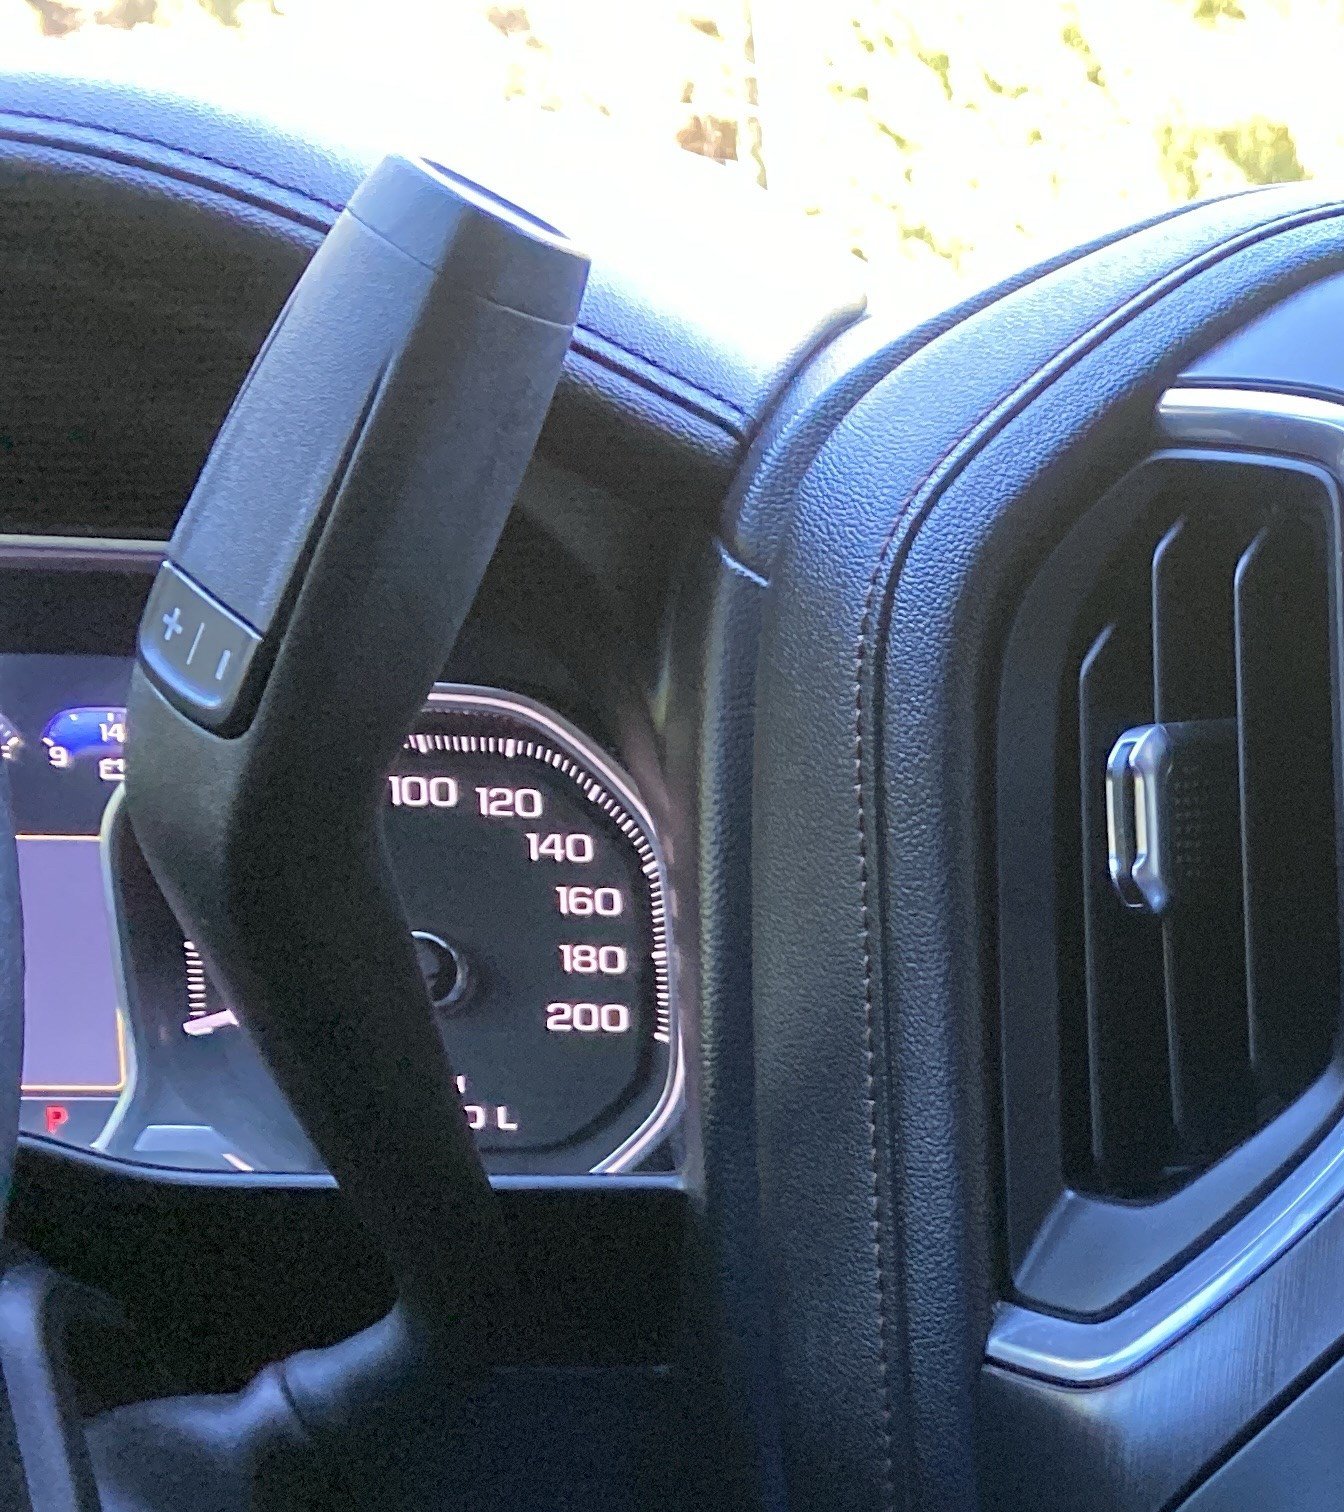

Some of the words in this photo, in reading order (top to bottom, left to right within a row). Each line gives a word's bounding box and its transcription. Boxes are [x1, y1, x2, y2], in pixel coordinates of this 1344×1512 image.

[48, 746, 68, 768] 9
[388, 775, 458, 808] 100
[475, 787, 543, 819] 120
[526, 832, 594, 864] 140
[556, 885, 623, 917] 160
[559, 944, 627, 975] 180
[545, 1001, 629, 1033] 200
